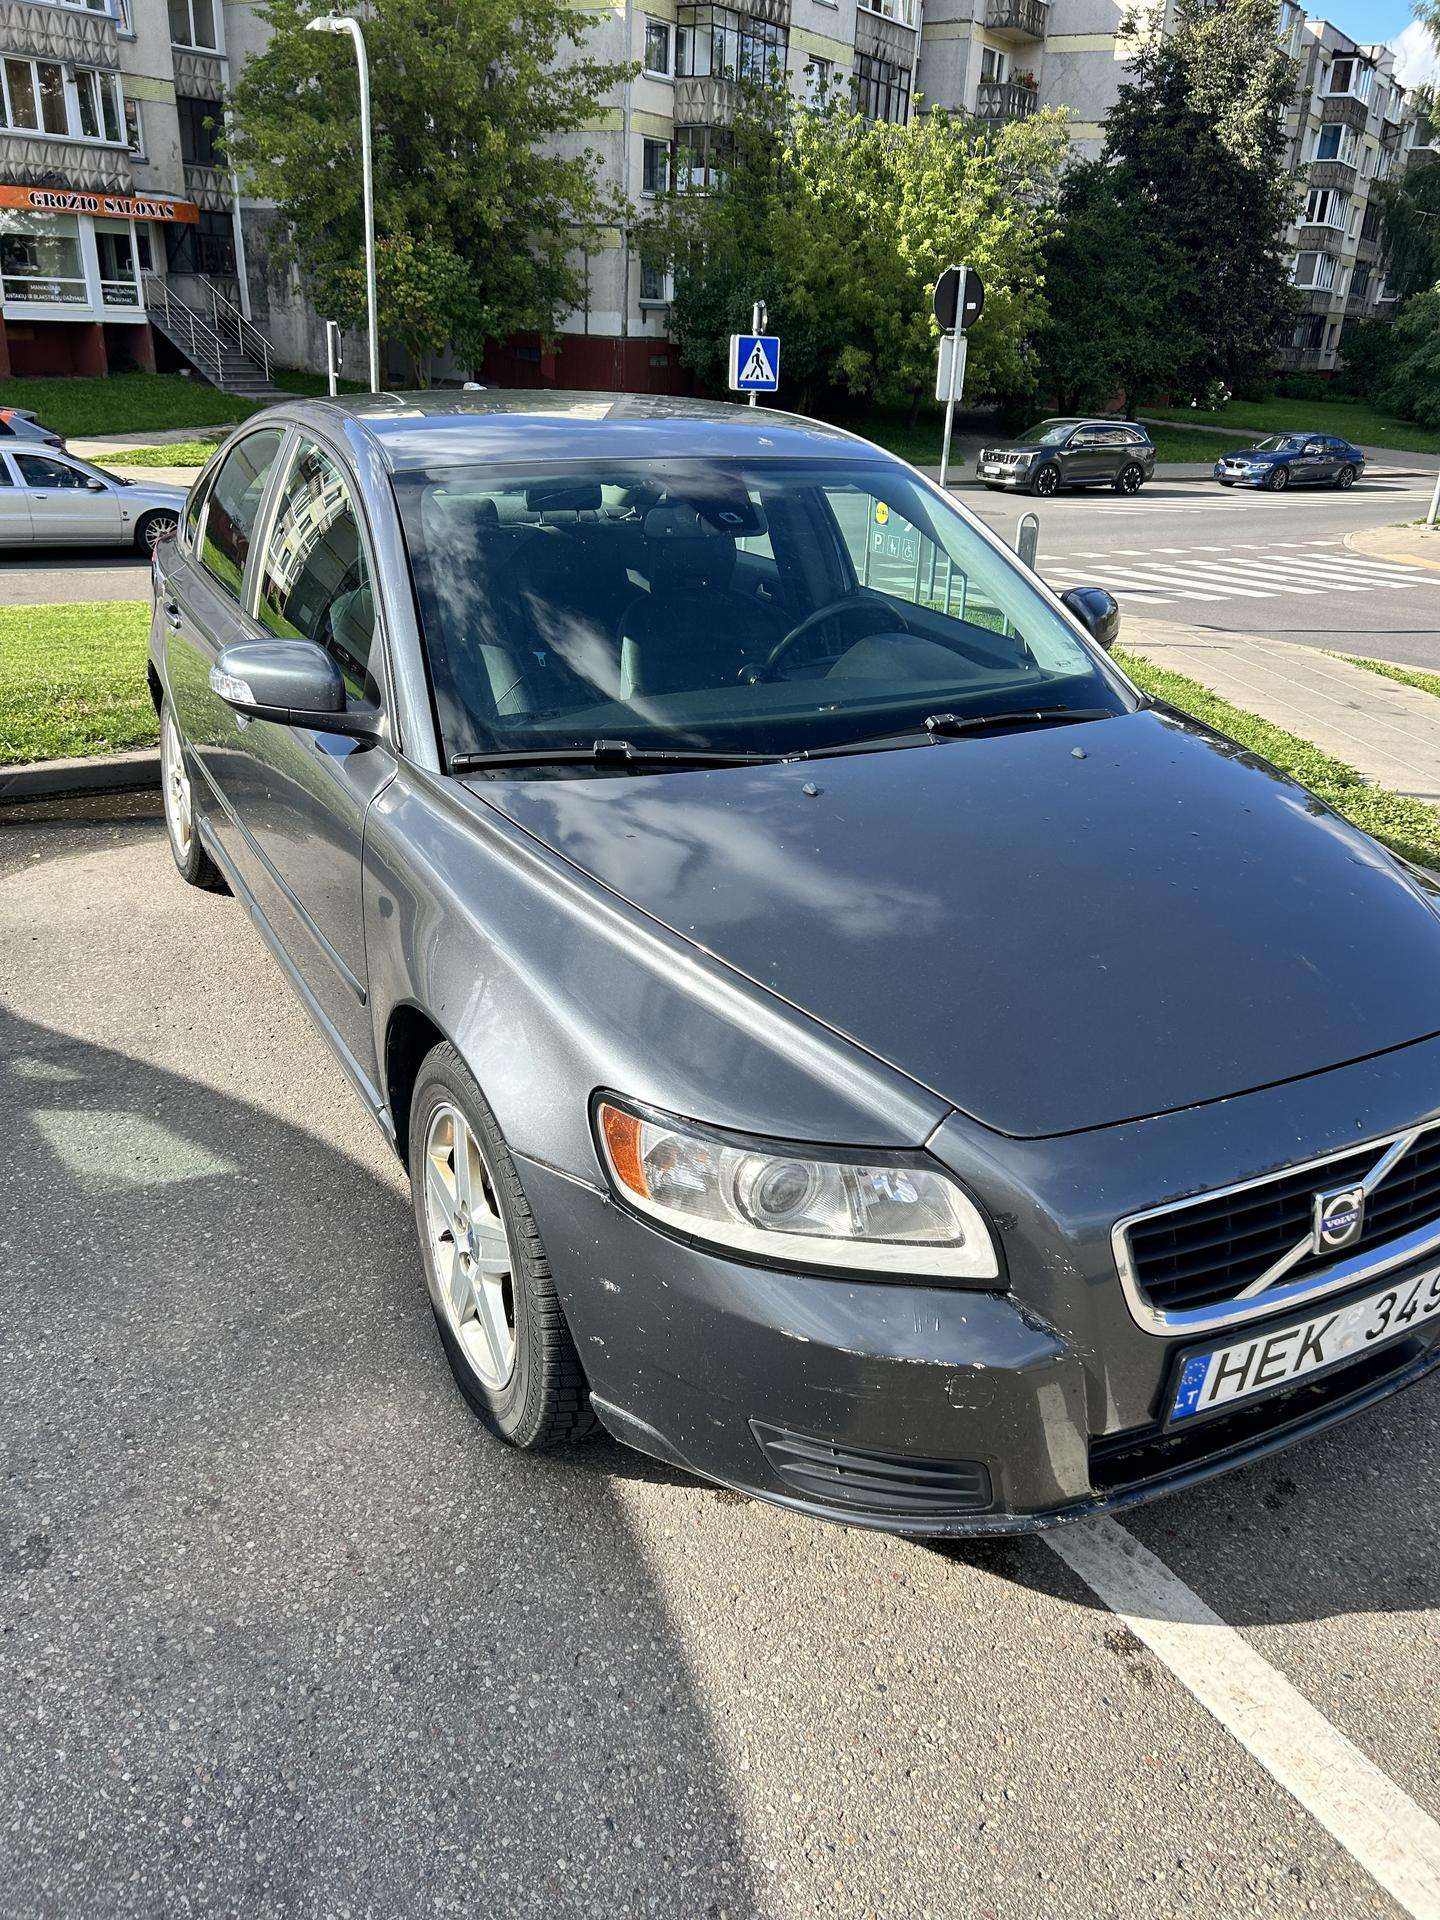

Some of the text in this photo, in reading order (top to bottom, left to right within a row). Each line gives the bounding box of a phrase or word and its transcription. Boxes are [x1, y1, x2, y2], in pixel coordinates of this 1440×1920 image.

[29, 191, 174, 218] GROŽIO SALONAS
[875, 533, 883, 550] P
[1326, 1212, 1358, 1228] VOLVO
[1208, 1314, 1339, 1402] HEK
[1174, 1390, 1199, 1409] LT
